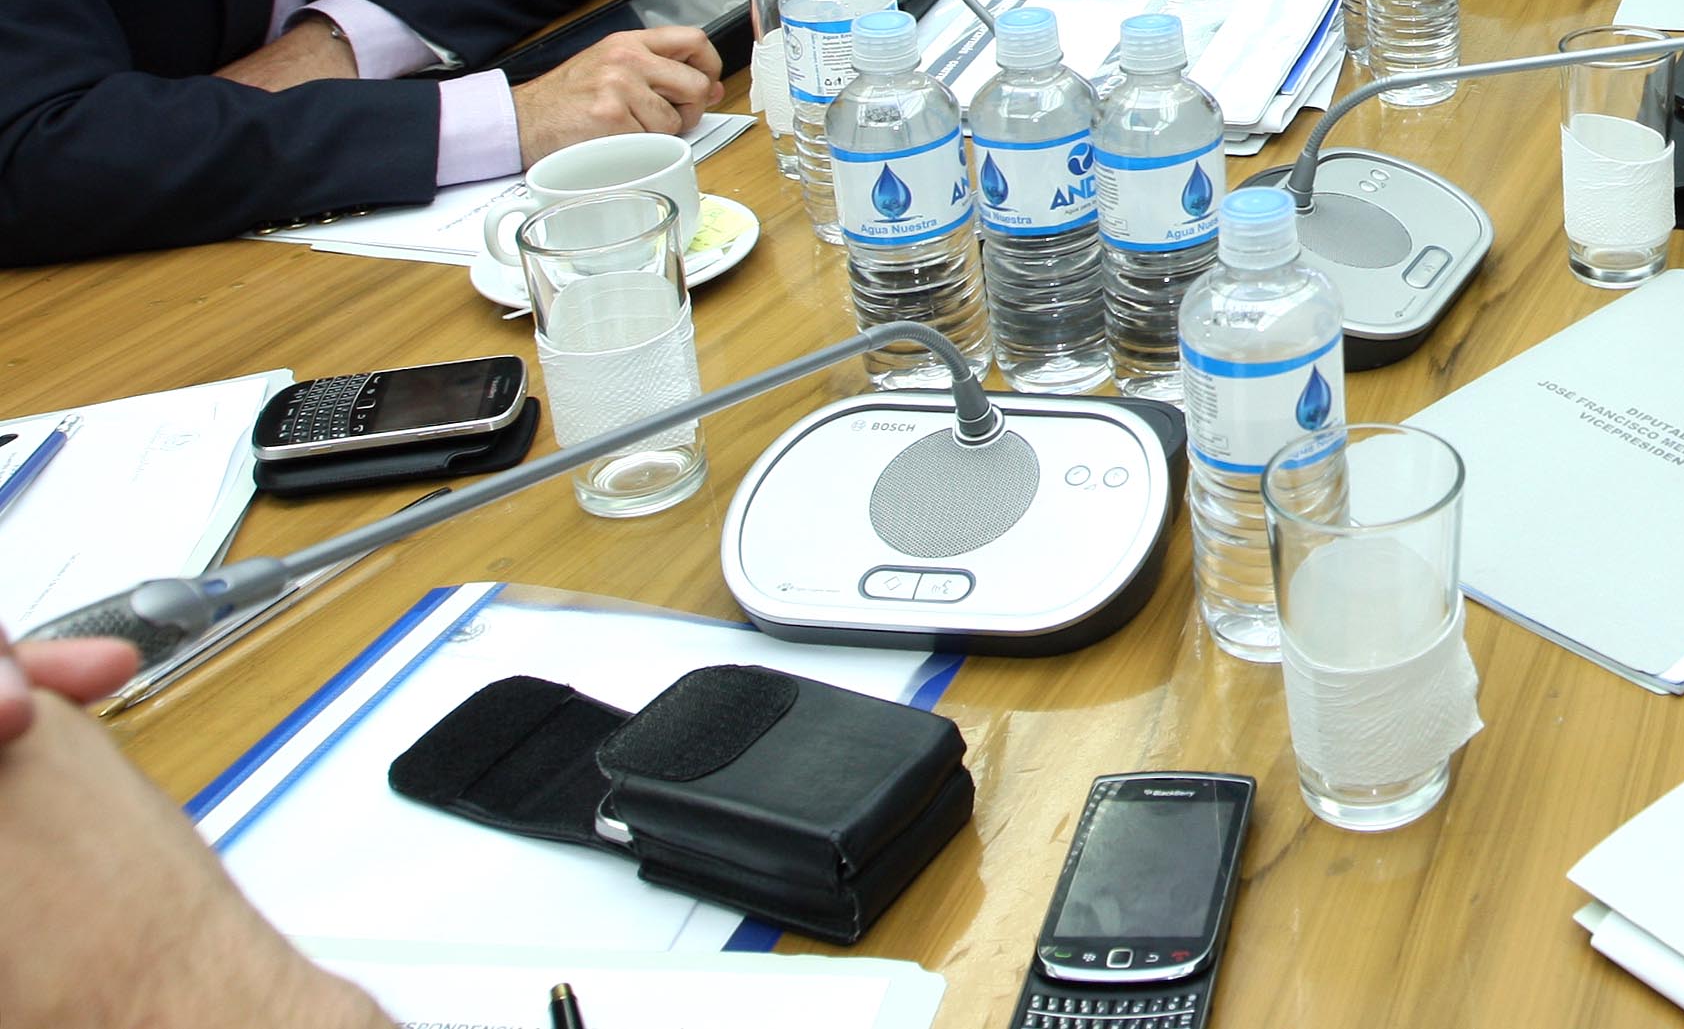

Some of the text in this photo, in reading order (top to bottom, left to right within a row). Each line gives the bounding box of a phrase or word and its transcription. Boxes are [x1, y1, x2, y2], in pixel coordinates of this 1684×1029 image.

[993, 213, 1032, 225] Nuestra
[860, 218, 938, 236] Agua Nuestra
[1165, 226, 1195, 240] Agua
[1576, 397, 1659, 439] FRANCISCO
[871, 422, 916, 433] BOSCH
